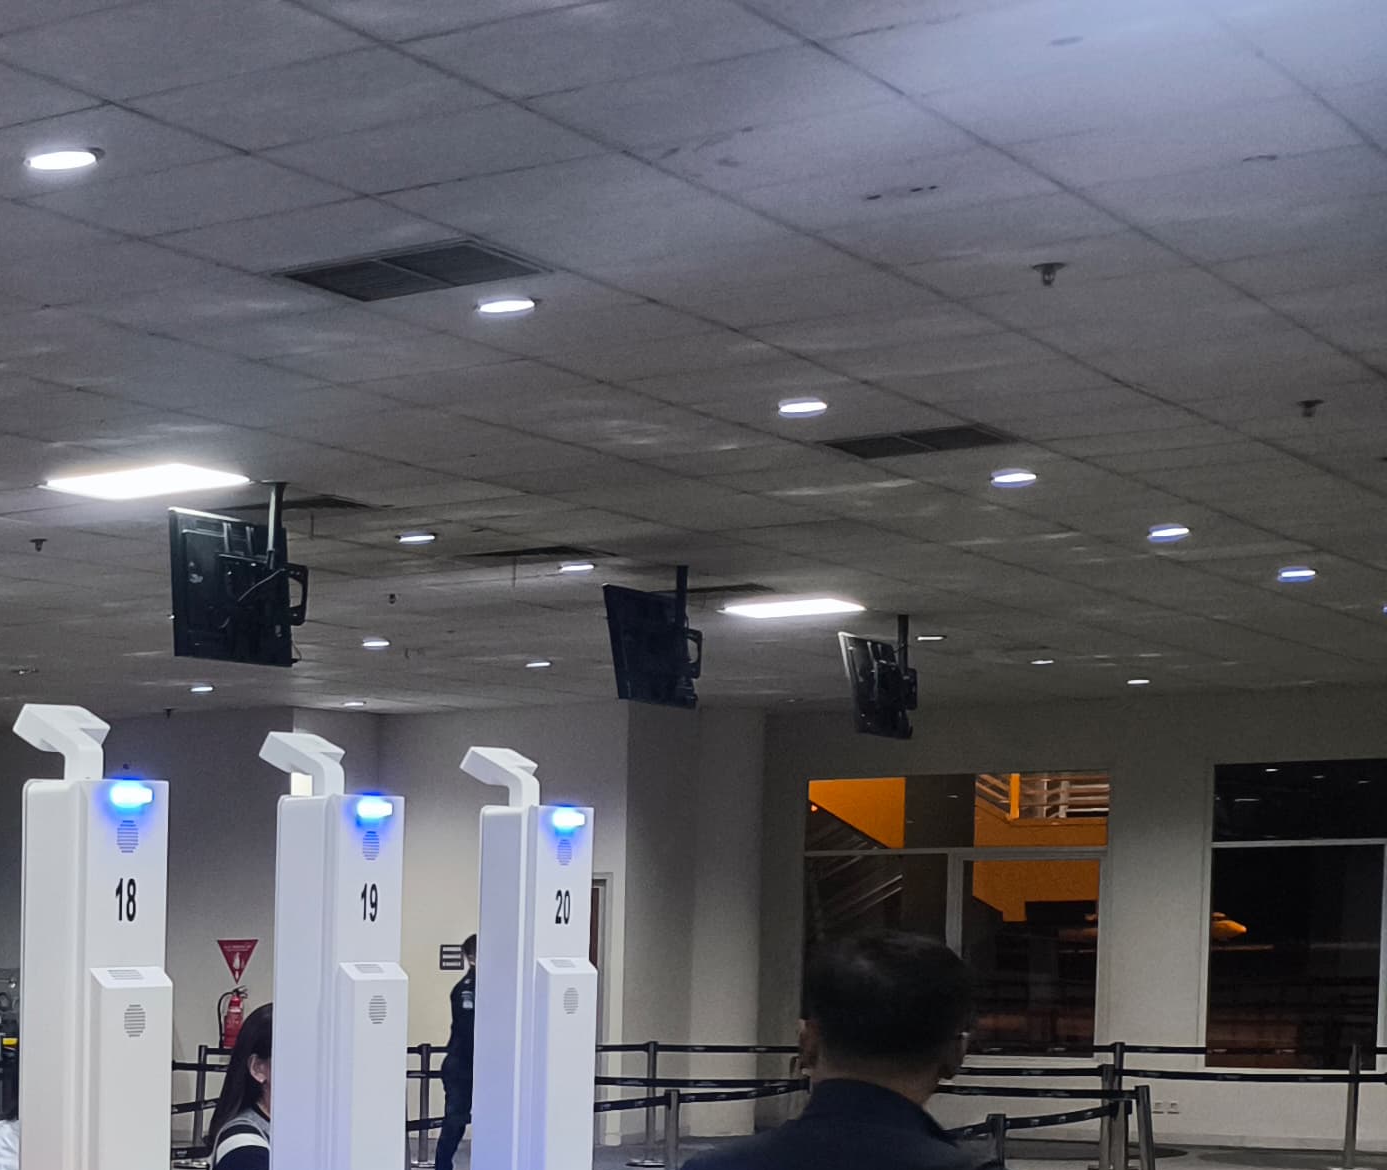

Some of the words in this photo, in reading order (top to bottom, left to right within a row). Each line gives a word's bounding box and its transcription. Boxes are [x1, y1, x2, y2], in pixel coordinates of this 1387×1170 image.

[115, 878, 136, 921] 18
[361, 883, 378, 922] 19
[555, 889, 570, 924] 20
